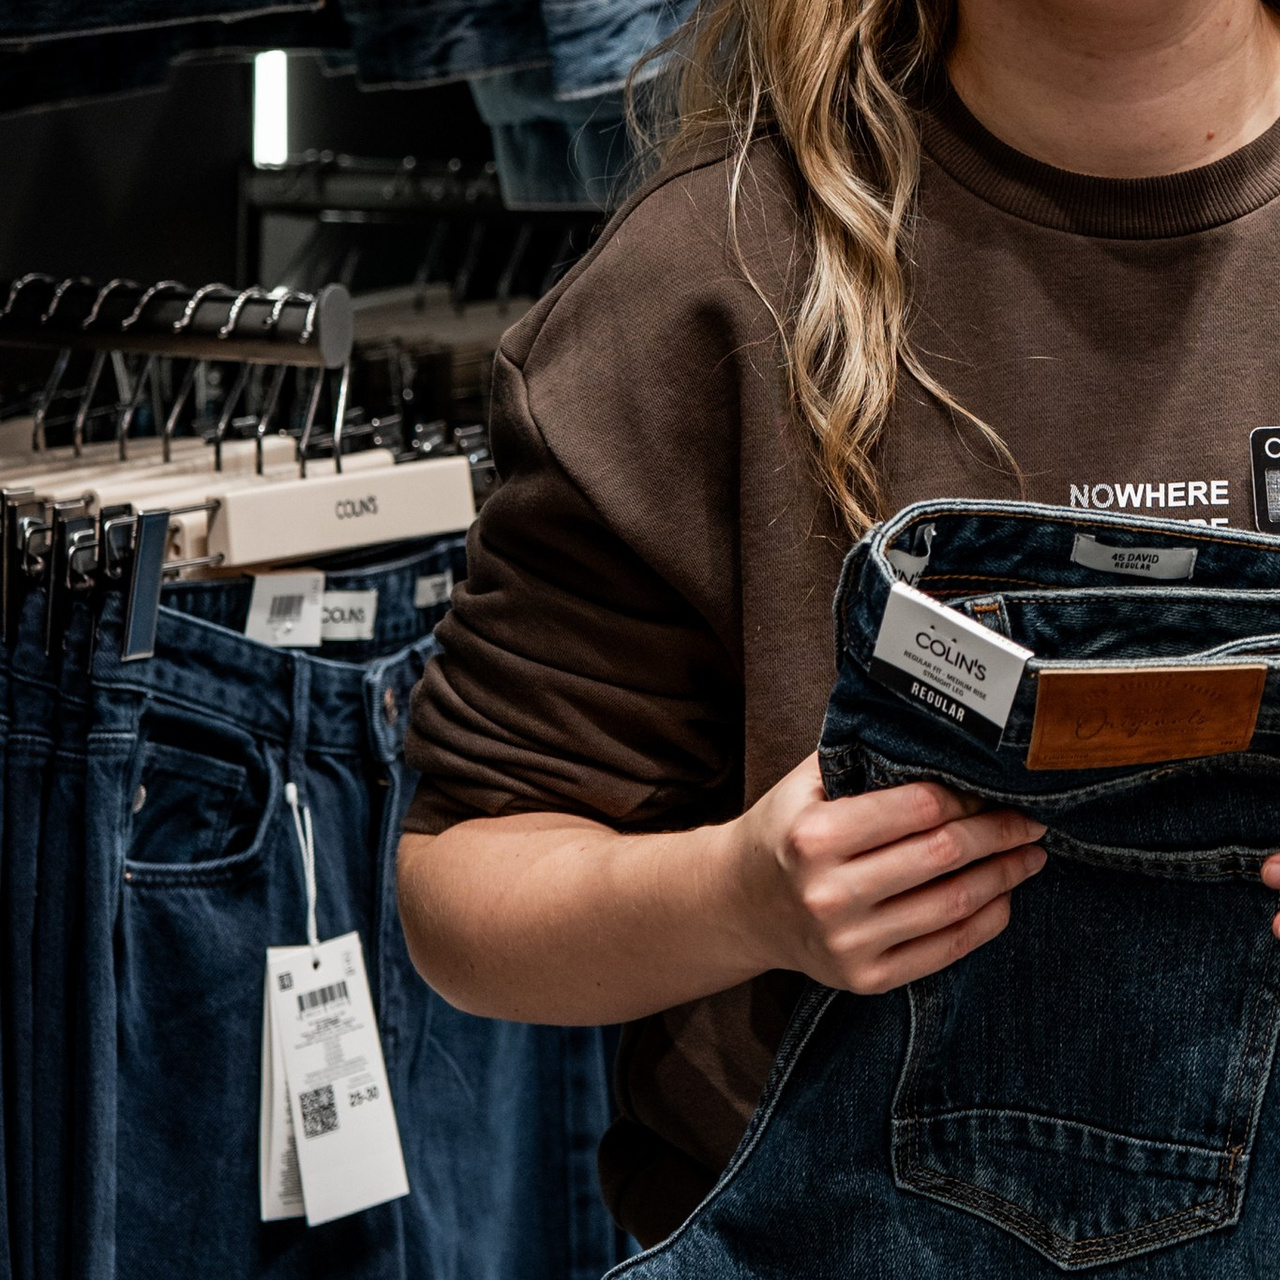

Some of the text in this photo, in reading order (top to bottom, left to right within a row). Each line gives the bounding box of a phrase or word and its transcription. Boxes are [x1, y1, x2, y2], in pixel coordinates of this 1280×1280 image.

[1069, 480, 1230, 508] NOWHERE
[1111, 553, 1160, 564] 45 DAVID
[1114, 562, 1151, 571] REGULAR
[915, 631, 987, 681] COLIN'S
[903, 650, 932, 669] REGULAR
[933, 665, 942, 674] FIT
[946, 673, 972, 691] MEDIUM
[973, 688, 987, 700] RISE
[922, 669, 964, 697] STRAIGHT LEG
[911, 681, 965, 722] REGULAR
